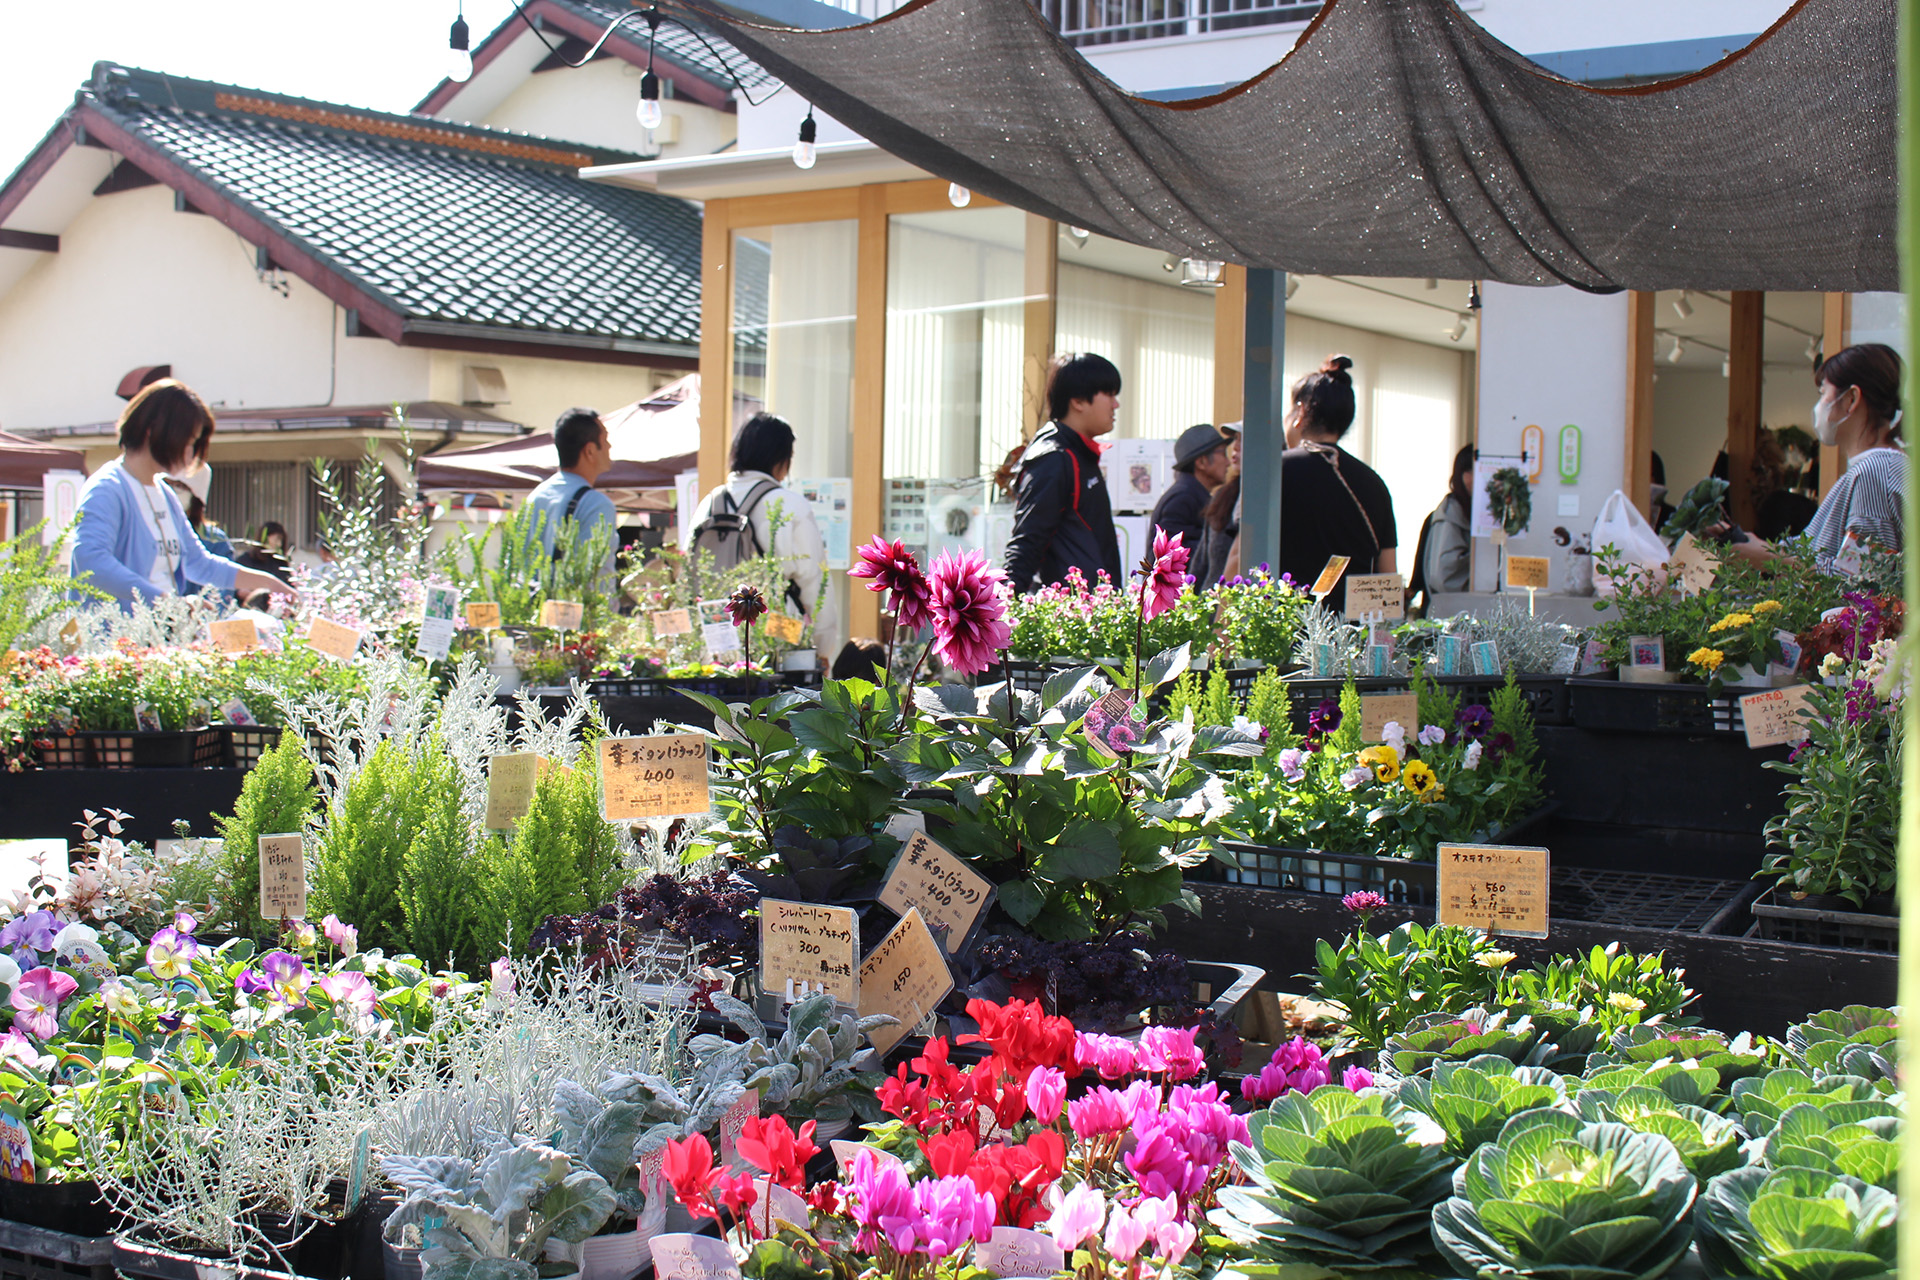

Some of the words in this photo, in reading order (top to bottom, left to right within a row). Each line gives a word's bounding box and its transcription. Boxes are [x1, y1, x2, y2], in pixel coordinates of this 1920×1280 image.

[643, 767, 675, 784] 400
[927, 883, 952, 906] 400
[1486, 882, 1506, 892] 560
[779, 906, 831, 922] シルバーリーフ
[799, 940, 820, 954] 300
[893, 967, 911, 992] 450
[679, 1257, 732, 1279] Garden
[1000, 1250, 1055, 1276] Garden
